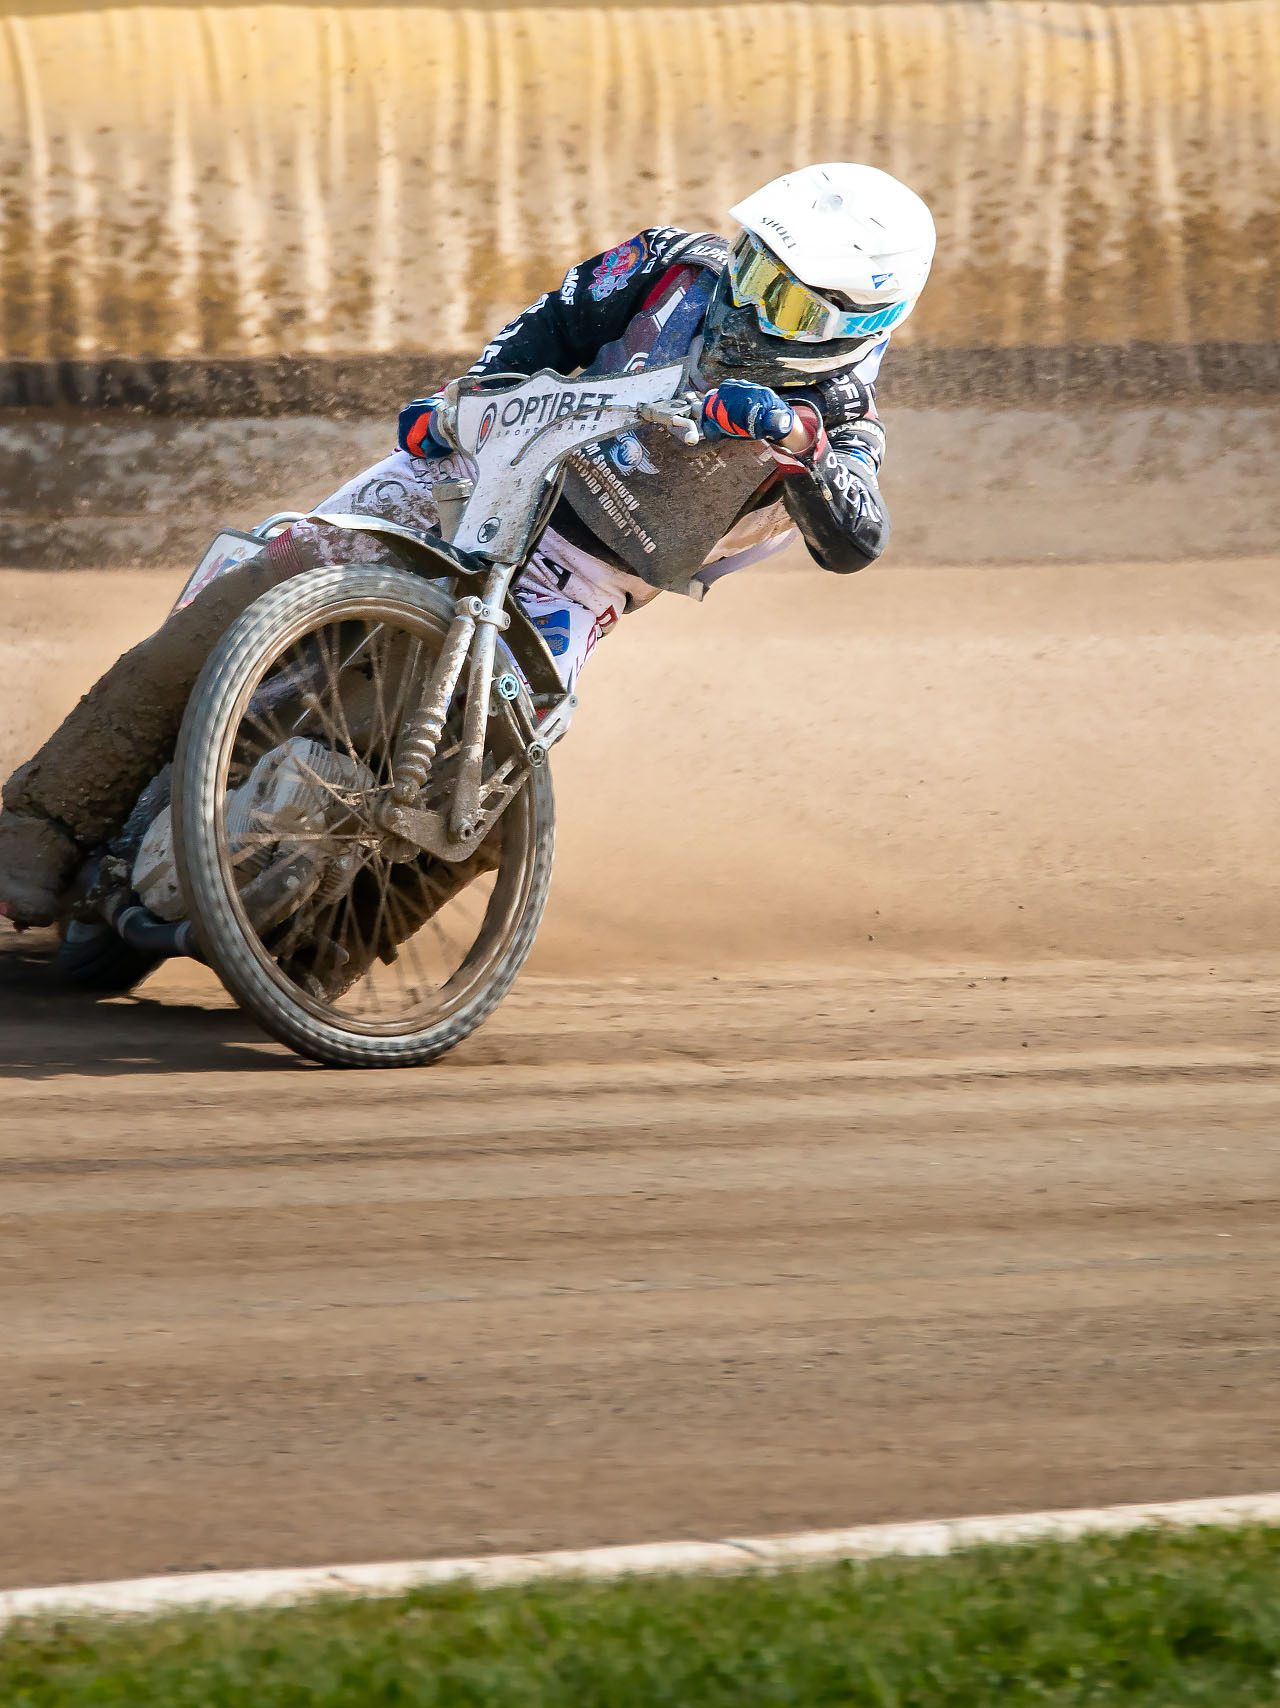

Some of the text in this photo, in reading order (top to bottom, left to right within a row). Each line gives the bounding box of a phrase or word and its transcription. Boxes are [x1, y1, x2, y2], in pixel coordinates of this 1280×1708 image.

[760, 217, 796, 249] SHOEI
[501, 391, 616, 427] OPTIBET
[592, 454, 640, 511] Speedway
[598, 491, 628, 530] Round
